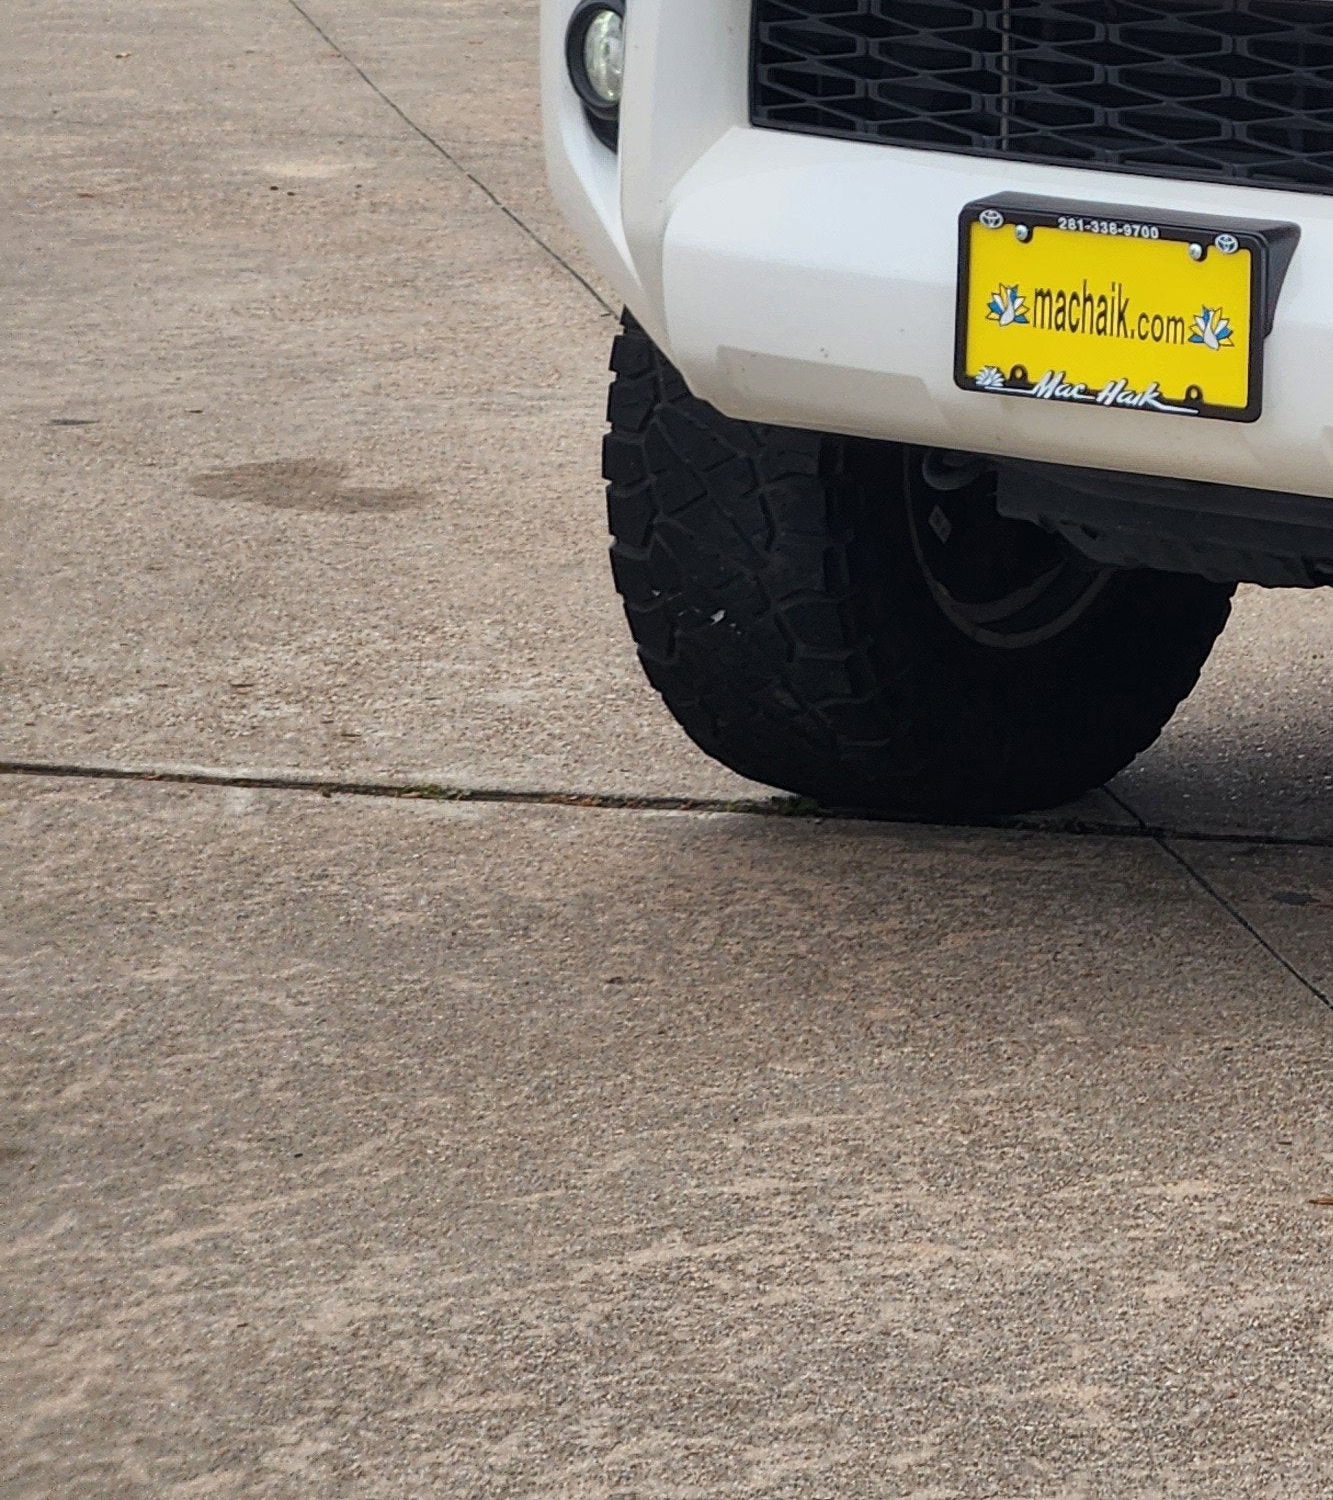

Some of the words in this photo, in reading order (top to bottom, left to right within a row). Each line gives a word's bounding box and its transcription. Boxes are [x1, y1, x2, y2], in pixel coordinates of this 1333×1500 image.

[1057, 215, 1160, 240] 281-338-9700
[1032, 279, 1186, 345] machaik.com
[1032, 369, 1095, 400] Mac
